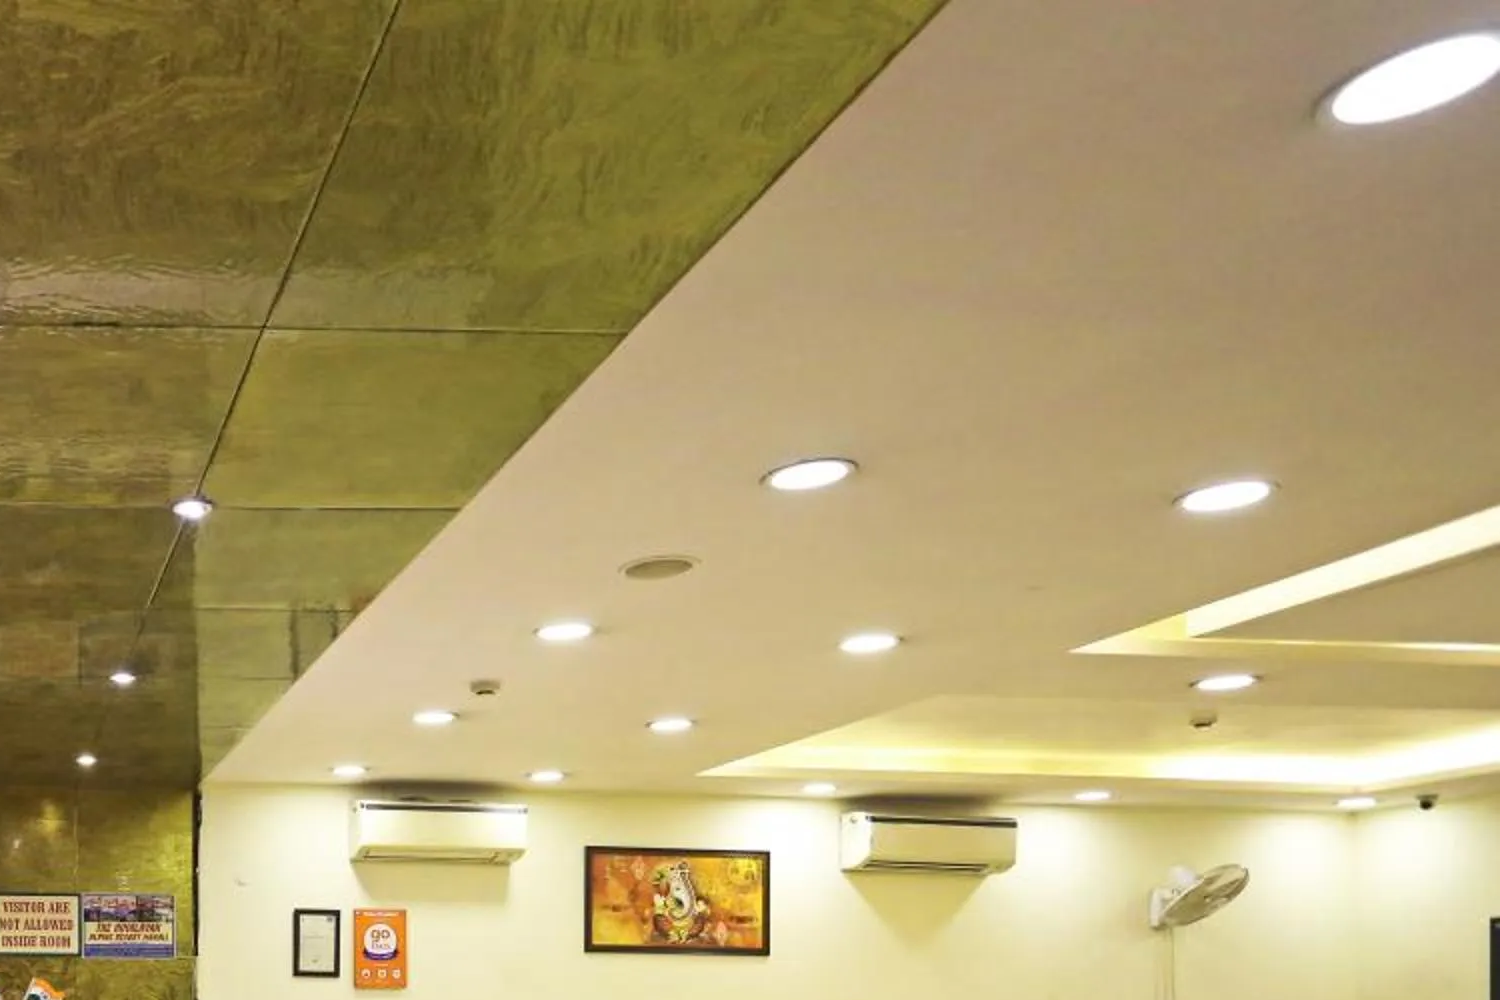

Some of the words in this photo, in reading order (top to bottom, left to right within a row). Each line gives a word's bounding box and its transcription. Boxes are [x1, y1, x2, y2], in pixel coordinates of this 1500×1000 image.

[3, 901, 45, 913] VISITOR
[48, 902, 70, 913] ARE
[0, 918, 20, 931] NOT
[23, 918, 73, 931] ALLOWED
[1, 935, 37, 948] INSIDE
[39, 935, 71, 948] ROOM
